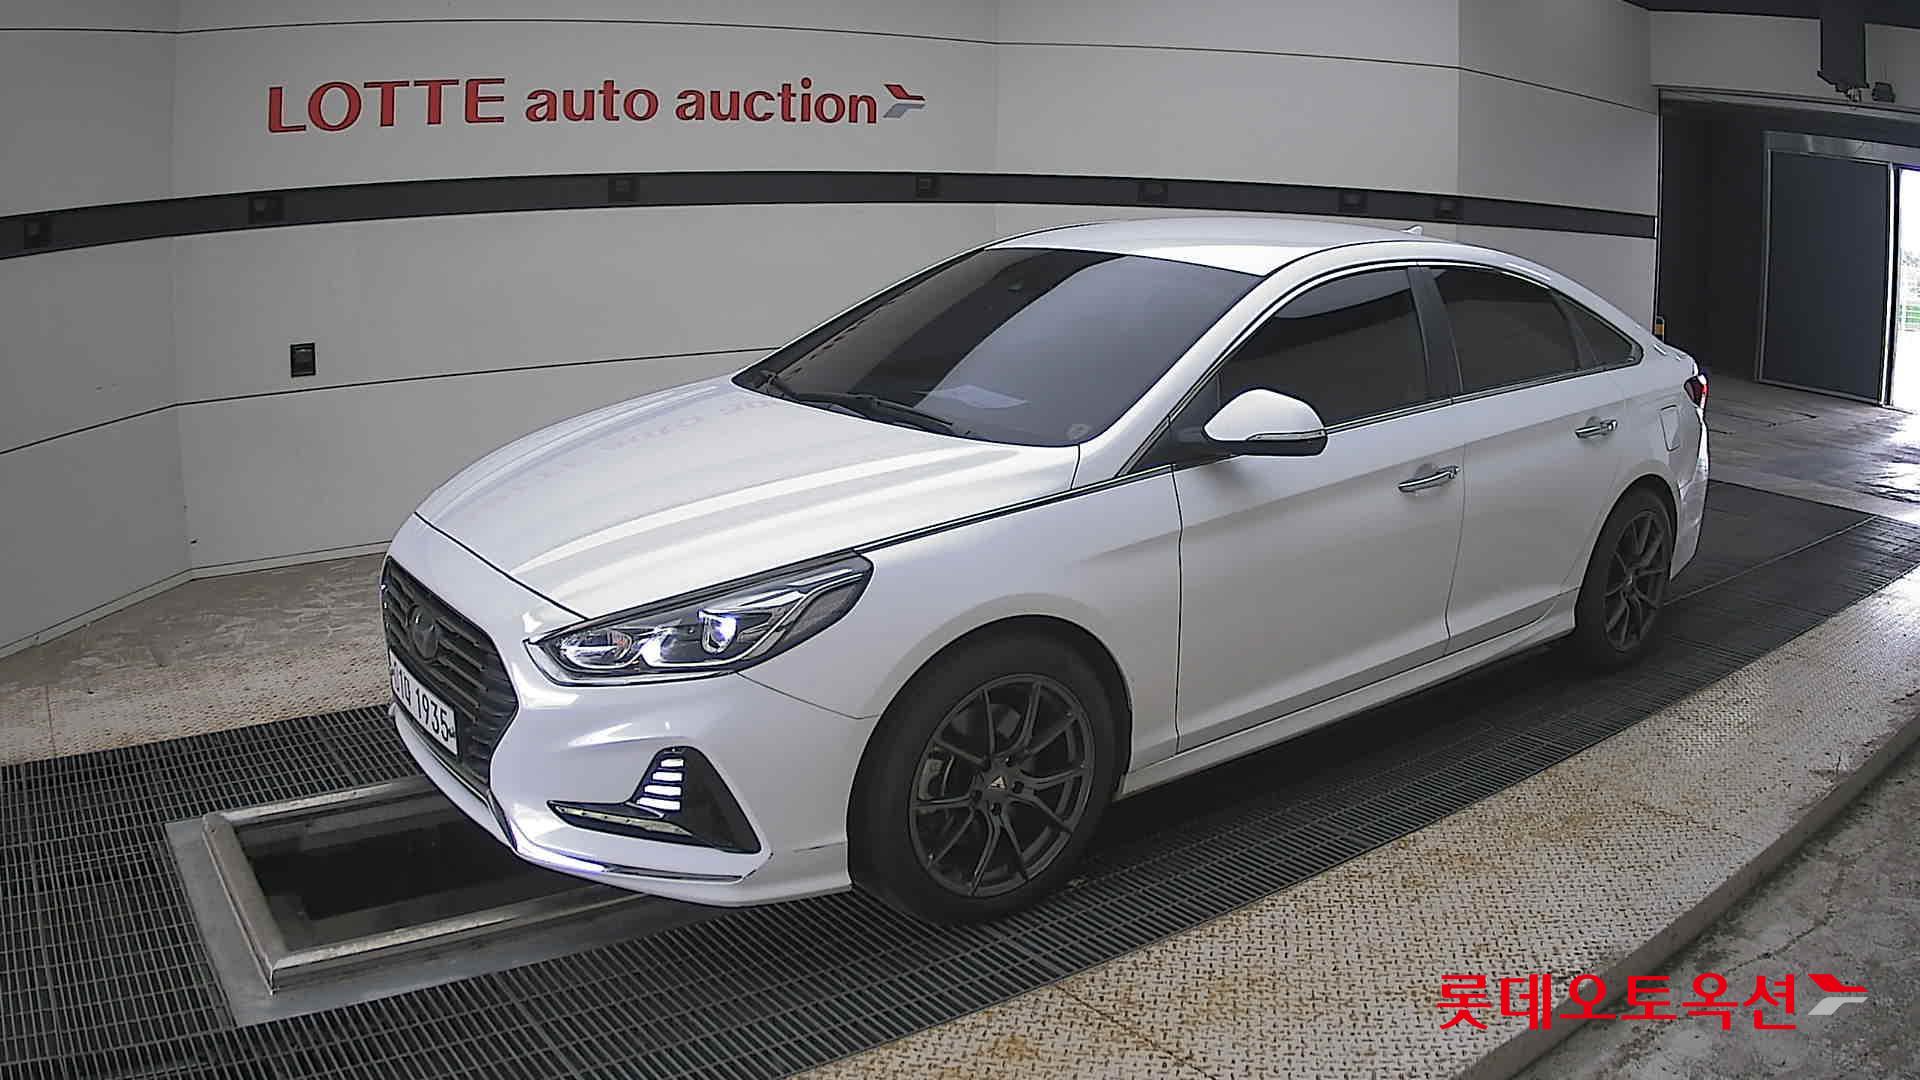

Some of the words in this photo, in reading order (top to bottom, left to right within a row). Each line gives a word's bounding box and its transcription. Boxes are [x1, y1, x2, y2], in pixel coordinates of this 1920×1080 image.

[268, 79, 504, 132] LOTTE
[526, 80, 658, 121] auto
[675, 77, 878, 125] auction
[415, 687, 449, 742] 1935
